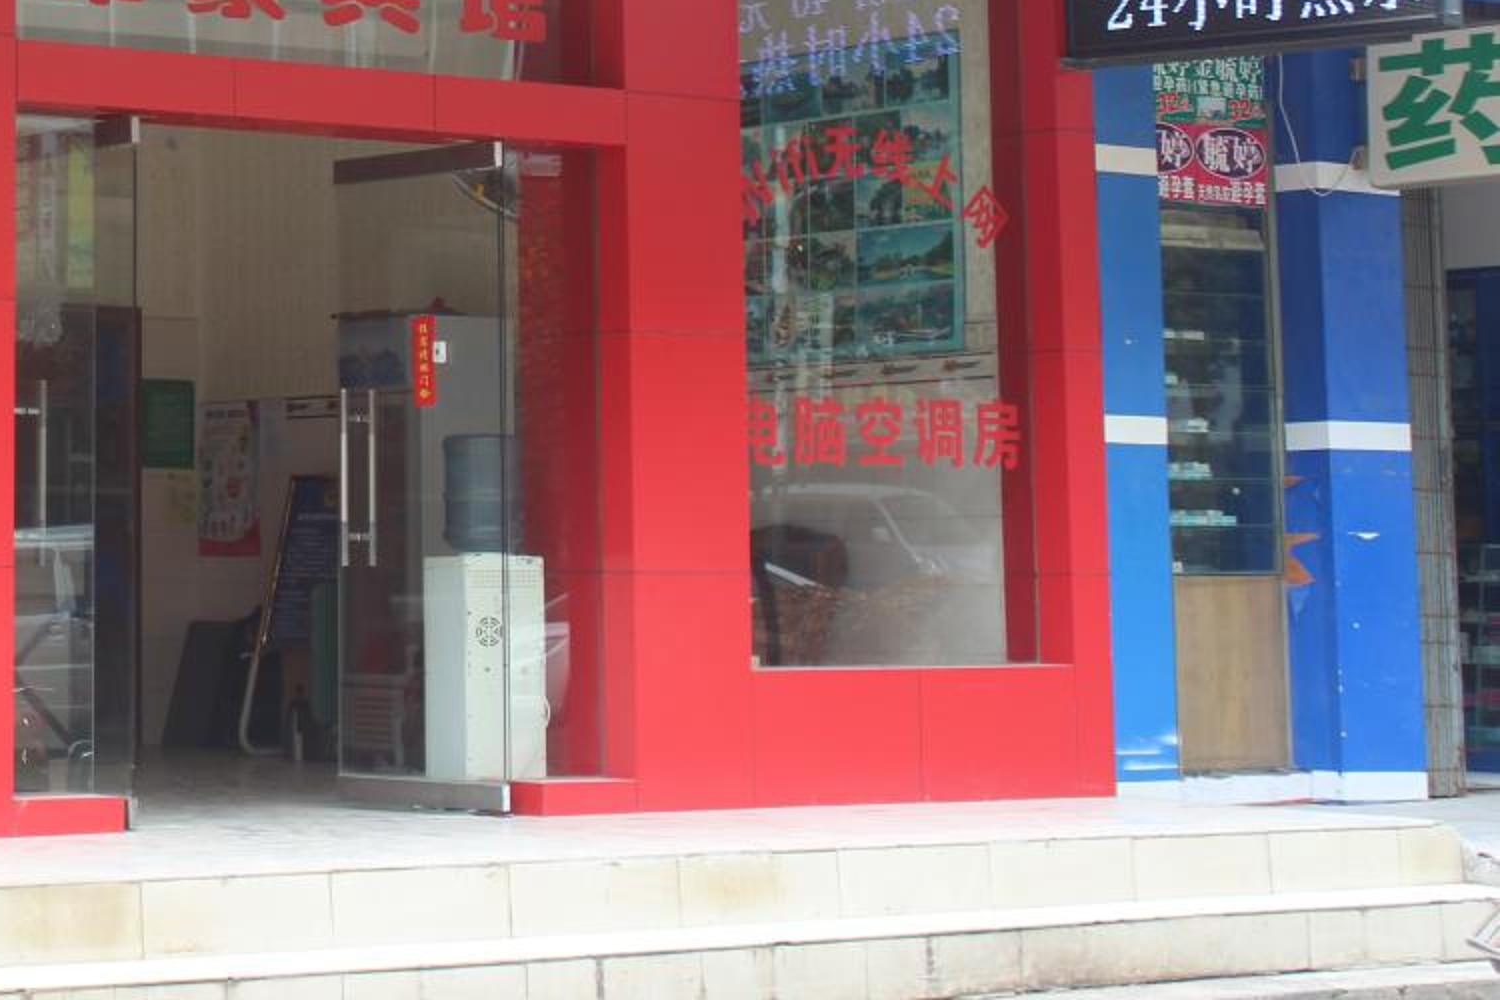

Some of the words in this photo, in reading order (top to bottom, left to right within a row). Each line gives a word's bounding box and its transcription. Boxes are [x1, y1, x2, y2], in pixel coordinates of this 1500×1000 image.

[748, 393, 1020, 471] 电脑空调房
